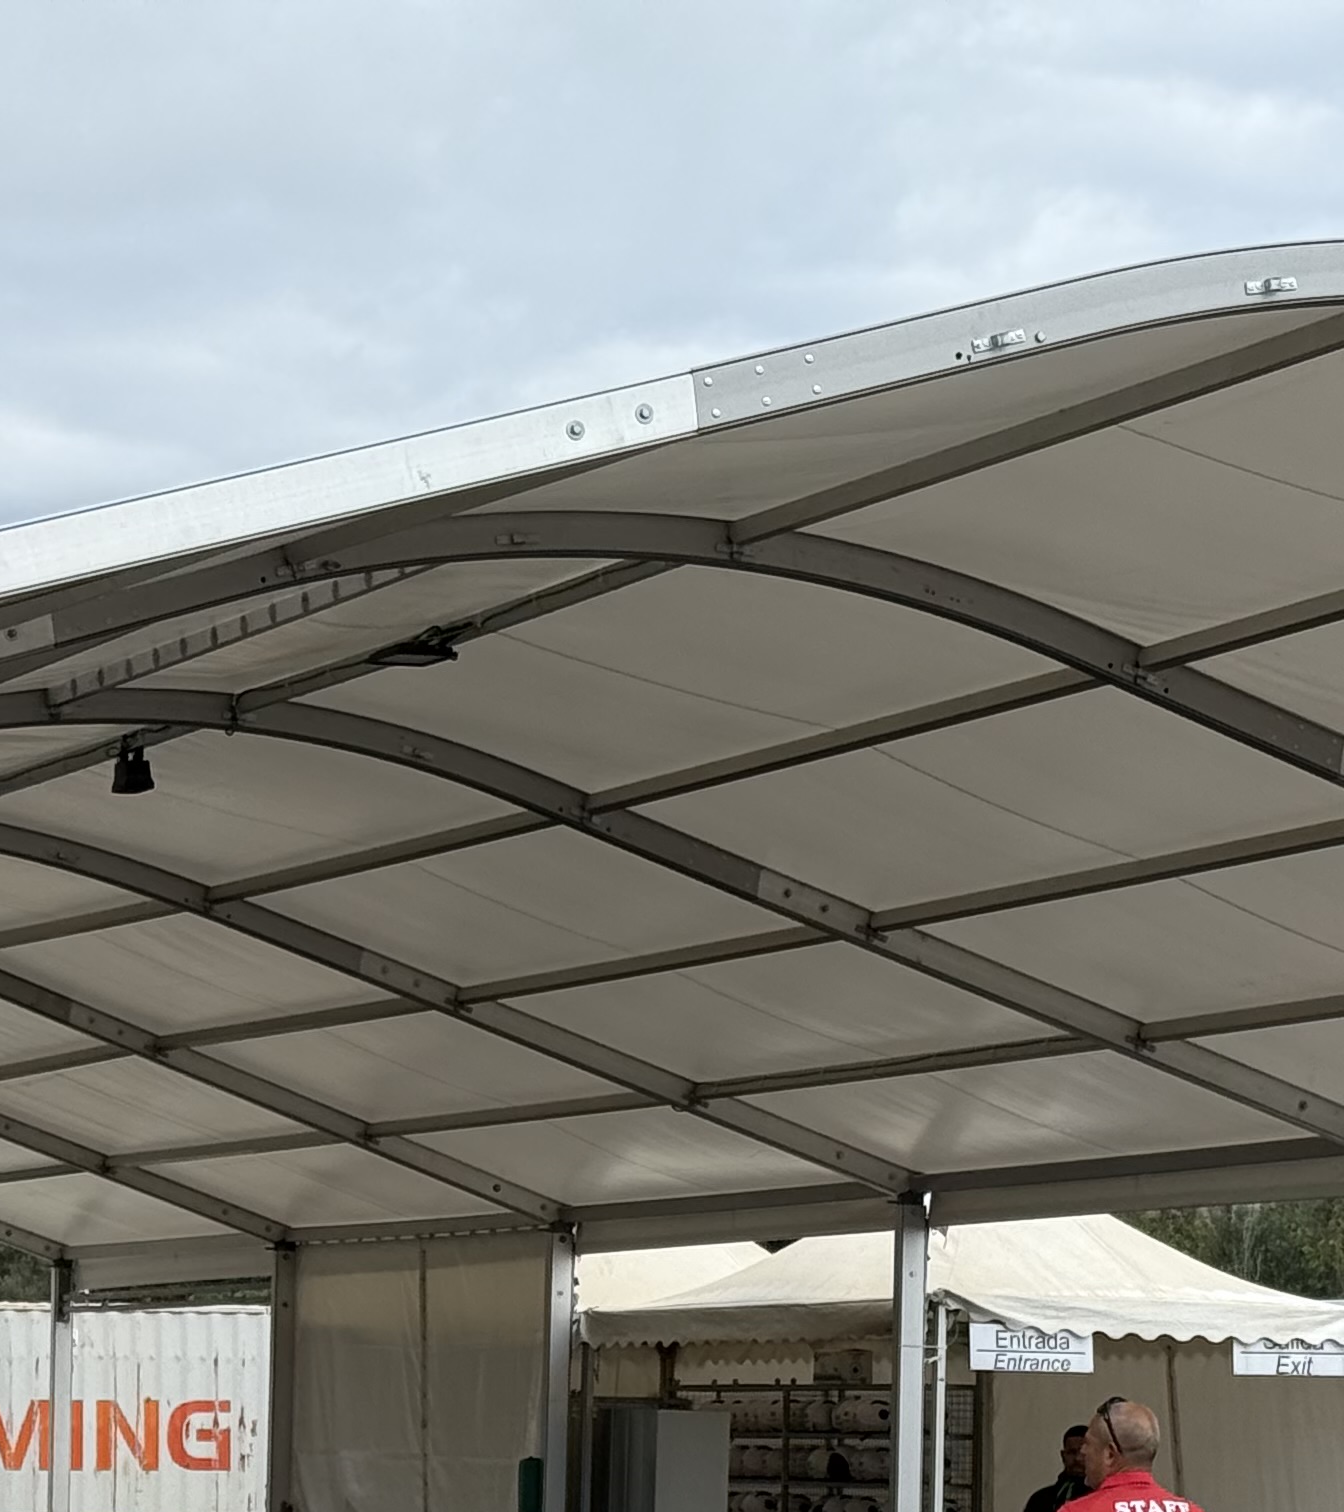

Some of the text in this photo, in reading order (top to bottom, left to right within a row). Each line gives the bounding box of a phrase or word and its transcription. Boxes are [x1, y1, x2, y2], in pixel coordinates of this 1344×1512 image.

[995, 1329, 1070, 1350] Entrada
[993, 1353, 1071, 1372] Entrance
[1276, 1355, 1314, 1376] Exit
